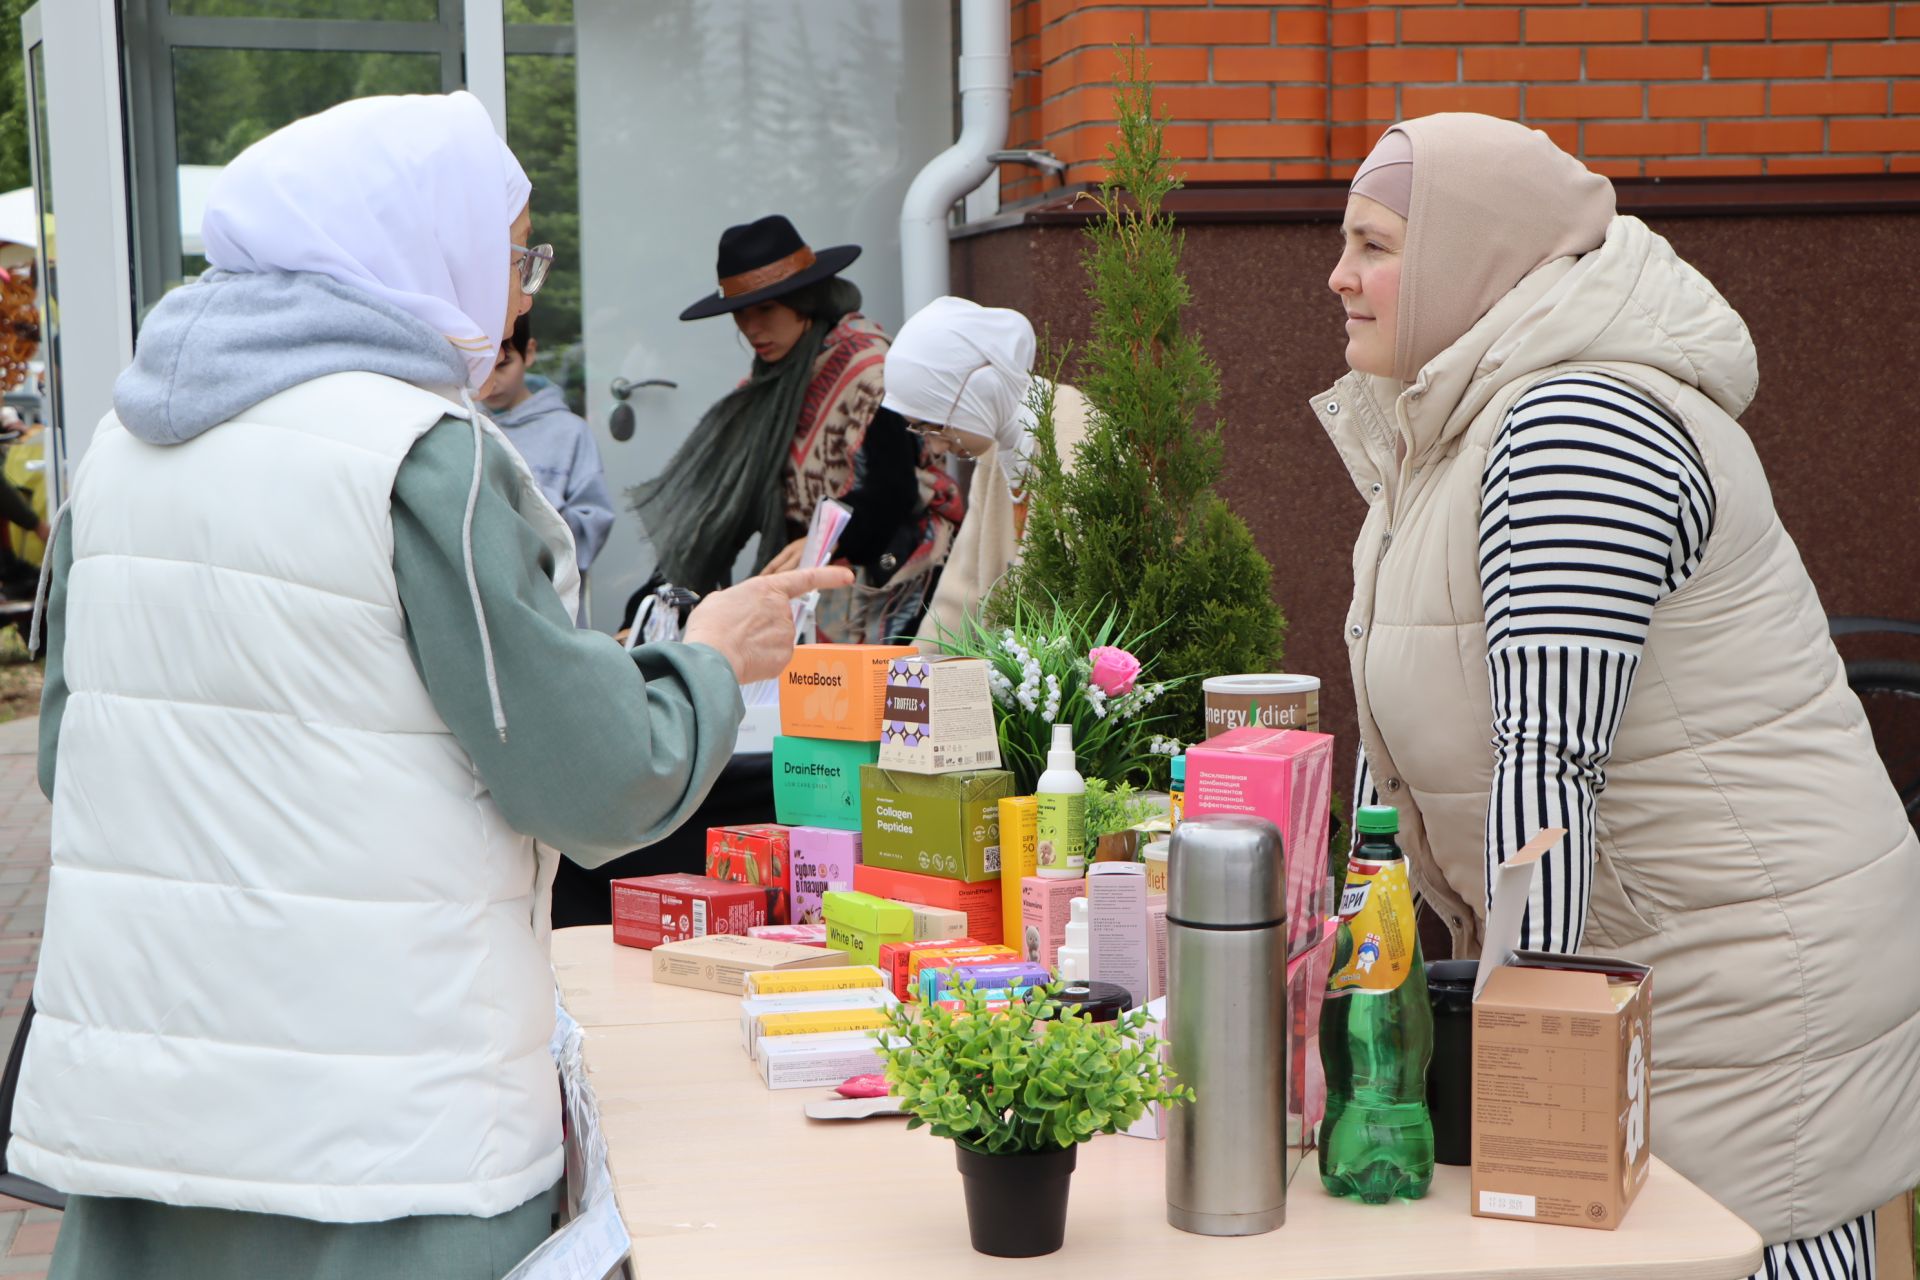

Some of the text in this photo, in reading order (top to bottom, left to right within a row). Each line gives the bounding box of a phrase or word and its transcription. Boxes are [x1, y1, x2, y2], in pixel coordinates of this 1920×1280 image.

[789, 671, 841, 686] MetaBoost
[894, 697, 918, 711] TRUFFLES
[1262, 705, 1296, 725] diet
[784, 762, 840, 777] DrainEffect
[1199, 787, 1243, 795] компонентов
[877, 806, 912, 820] Collagen
[877, 820, 913, 834] Peptides
[1023, 843, 1035, 853] 50
[795, 863, 816, 880] суфле
[830, 928, 863, 950] White Tea
